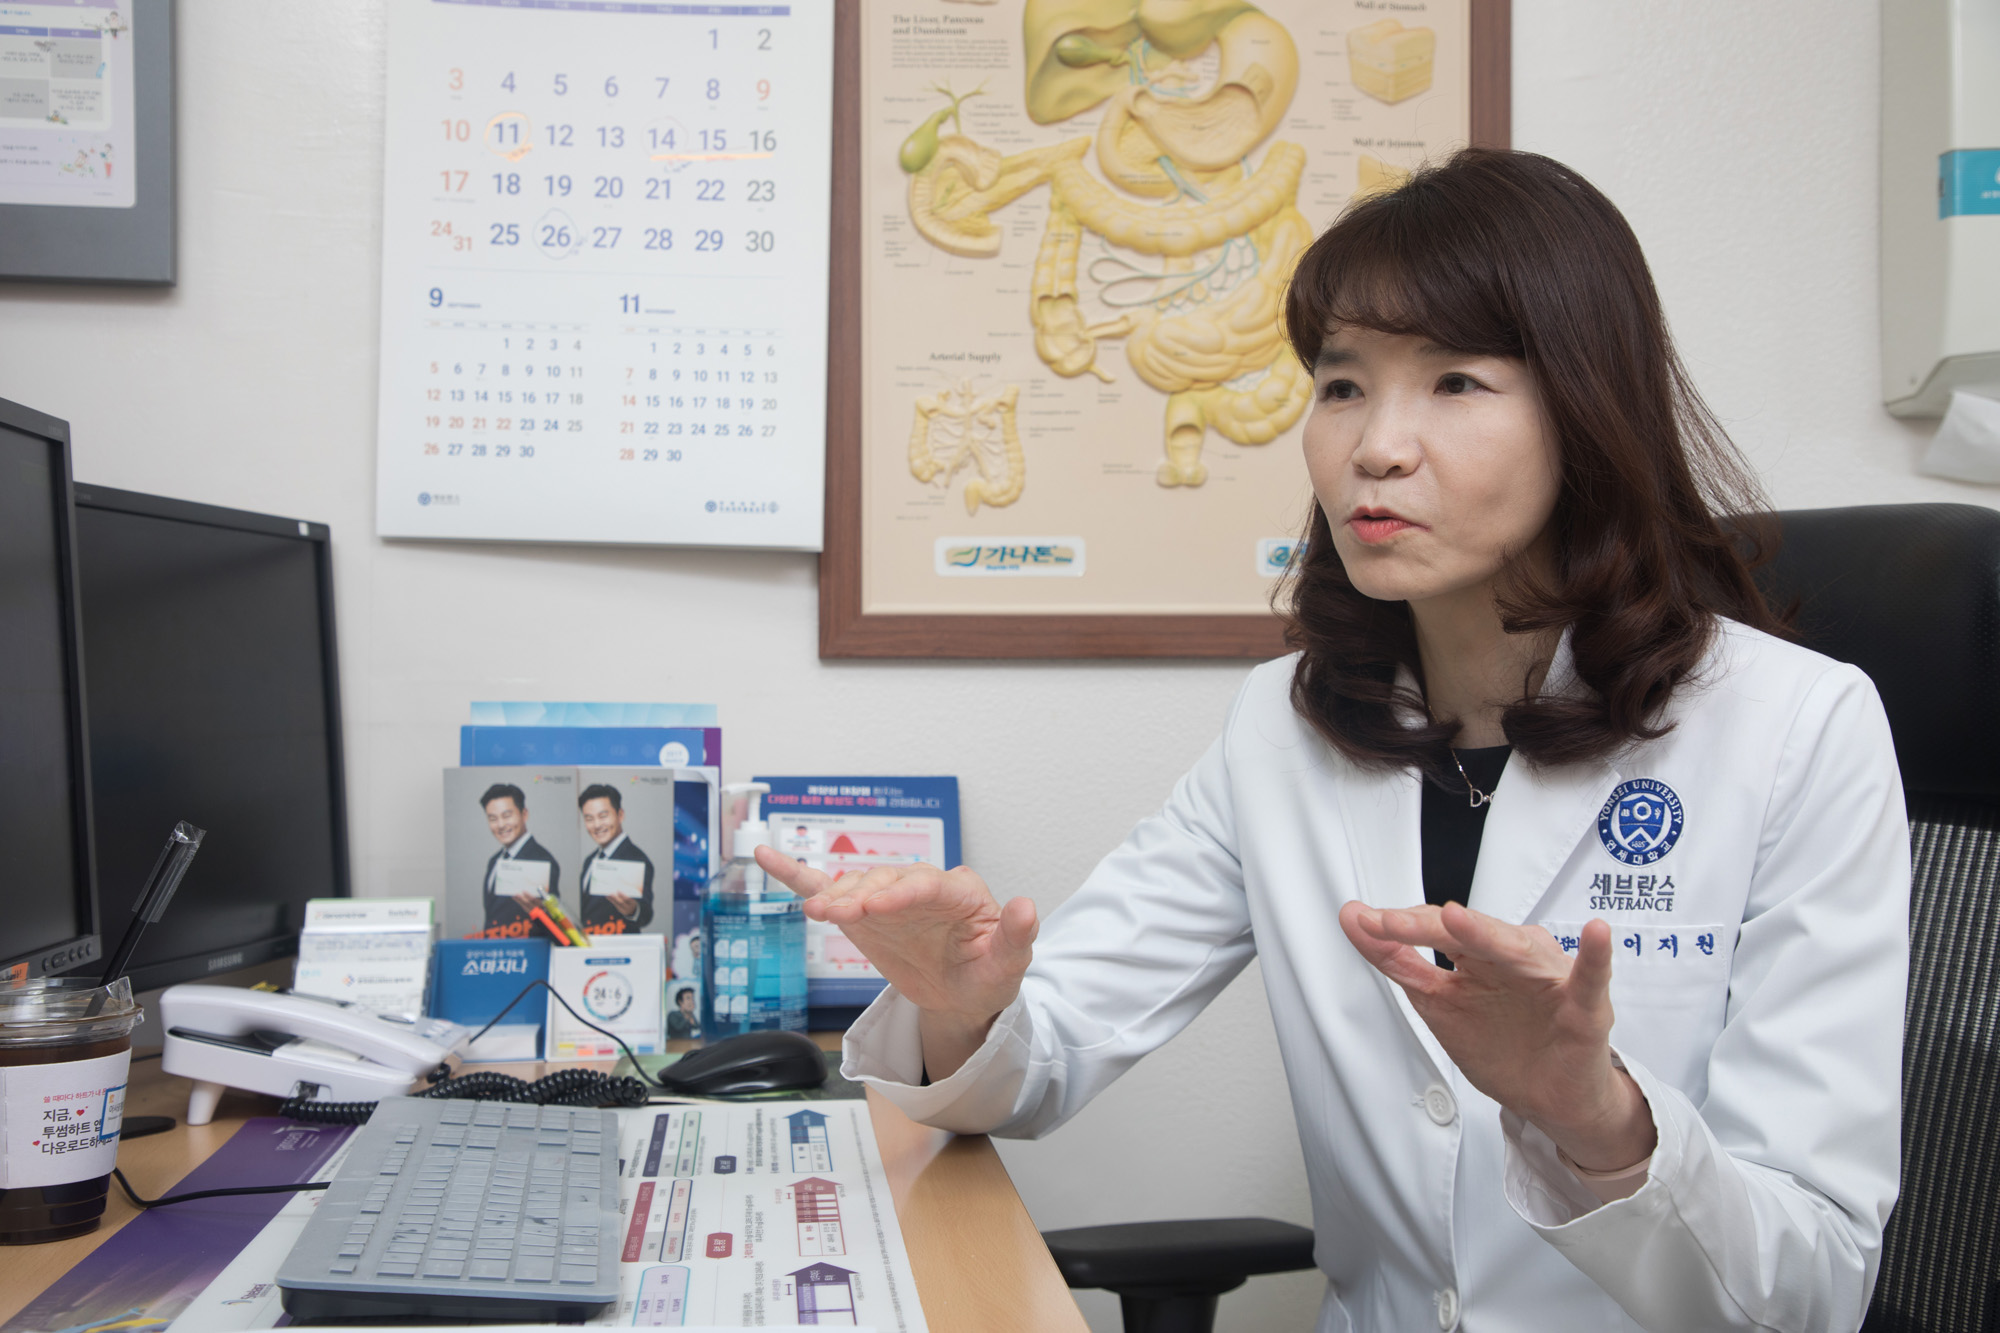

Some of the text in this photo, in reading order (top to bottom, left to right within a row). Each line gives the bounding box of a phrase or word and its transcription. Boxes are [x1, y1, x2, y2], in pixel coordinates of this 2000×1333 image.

[709, 28, 771, 50] 1 2
[449, 67, 771, 101] 3 4 5 6 7 8 9
[441, 119, 777, 152] 10 11 12 13 14 15 16
[440, 170, 775, 202] 17 18 19 20 21 22 23
[431, 221, 774, 252] 24 31 25 26 27 28 29 30
[429, 288, 443, 308] 9
[620, 293, 640, 314] 11
[504, 338, 581, 351] 1 2 3 4
[651, 342, 775, 356] 1 2 3 4 5 6
[431, 362, 582, 378] 5 6 7 8 9 10 11
[626, 368, 778, 383] 7 8 9 10 11 12 13
[427, 389, 583, 405] 12 13 14 15 16 17 18
[622, 395, 777, 410] 14 15 16 17 18 19 20
[426, 416, 582, 432] 19 20 21 22 23 24 25
[620, 421, 776, 437] 21 22 23 24 25 26 27
[424, 443, 534, 458] 26 27 28 29 30
[620, 448, 682, 462] 28 29 30
[1600, 780, 1683, 824] YONSEI UNIVERSITY
[1605, 840, 1672, 865] 연세대학교
[1589, 874, 1675, 896] 세브란스
[1590, 896, 1673, 912] SEVERANCE
[208, 952, 243, 971] SAMSUNG
[52, 1093, 74, 1102] 때마다
[75, 1090, 95, 1099] 하트가
[43, 1108, 72, 1122] 지금,
[42, 1122, 91, 1139] 투썸하트
